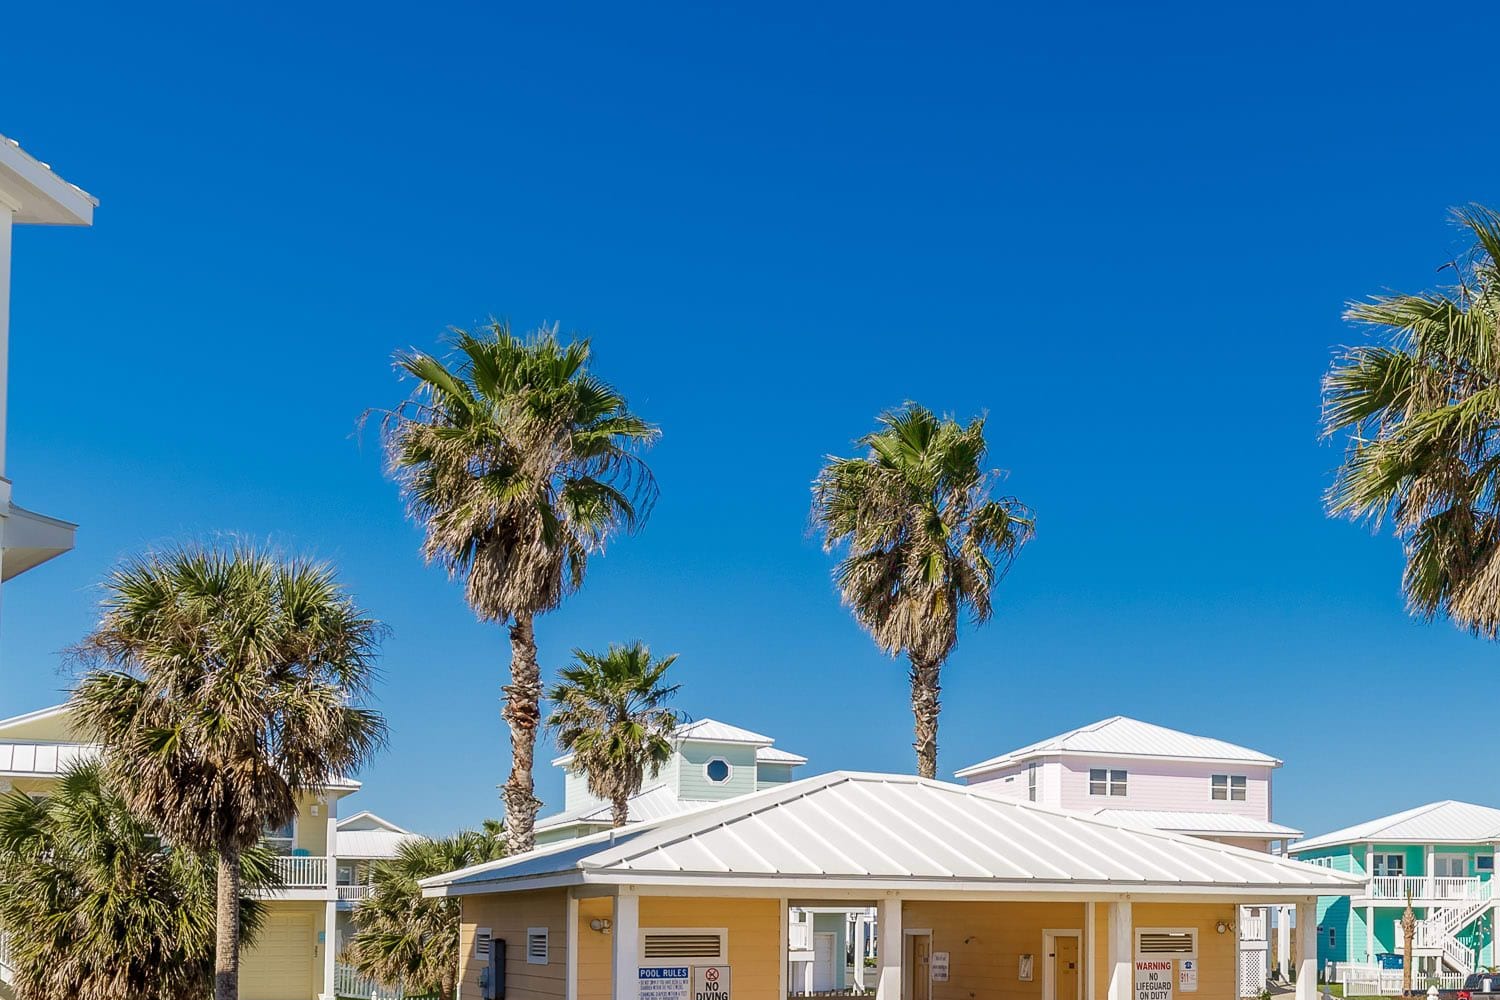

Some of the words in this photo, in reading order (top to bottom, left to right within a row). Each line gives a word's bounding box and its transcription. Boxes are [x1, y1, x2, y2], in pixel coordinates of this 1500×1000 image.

[1136, 962, 1171, 970] WARNING
[663, 969, 687, 977] RULES
[1149, 973, 1158, 981] NO
[705, 982, 719, 991] NO
[1136, 982, 1171, 990] LIFEGUARD
[1140, 992, 1149, 1000] ON
